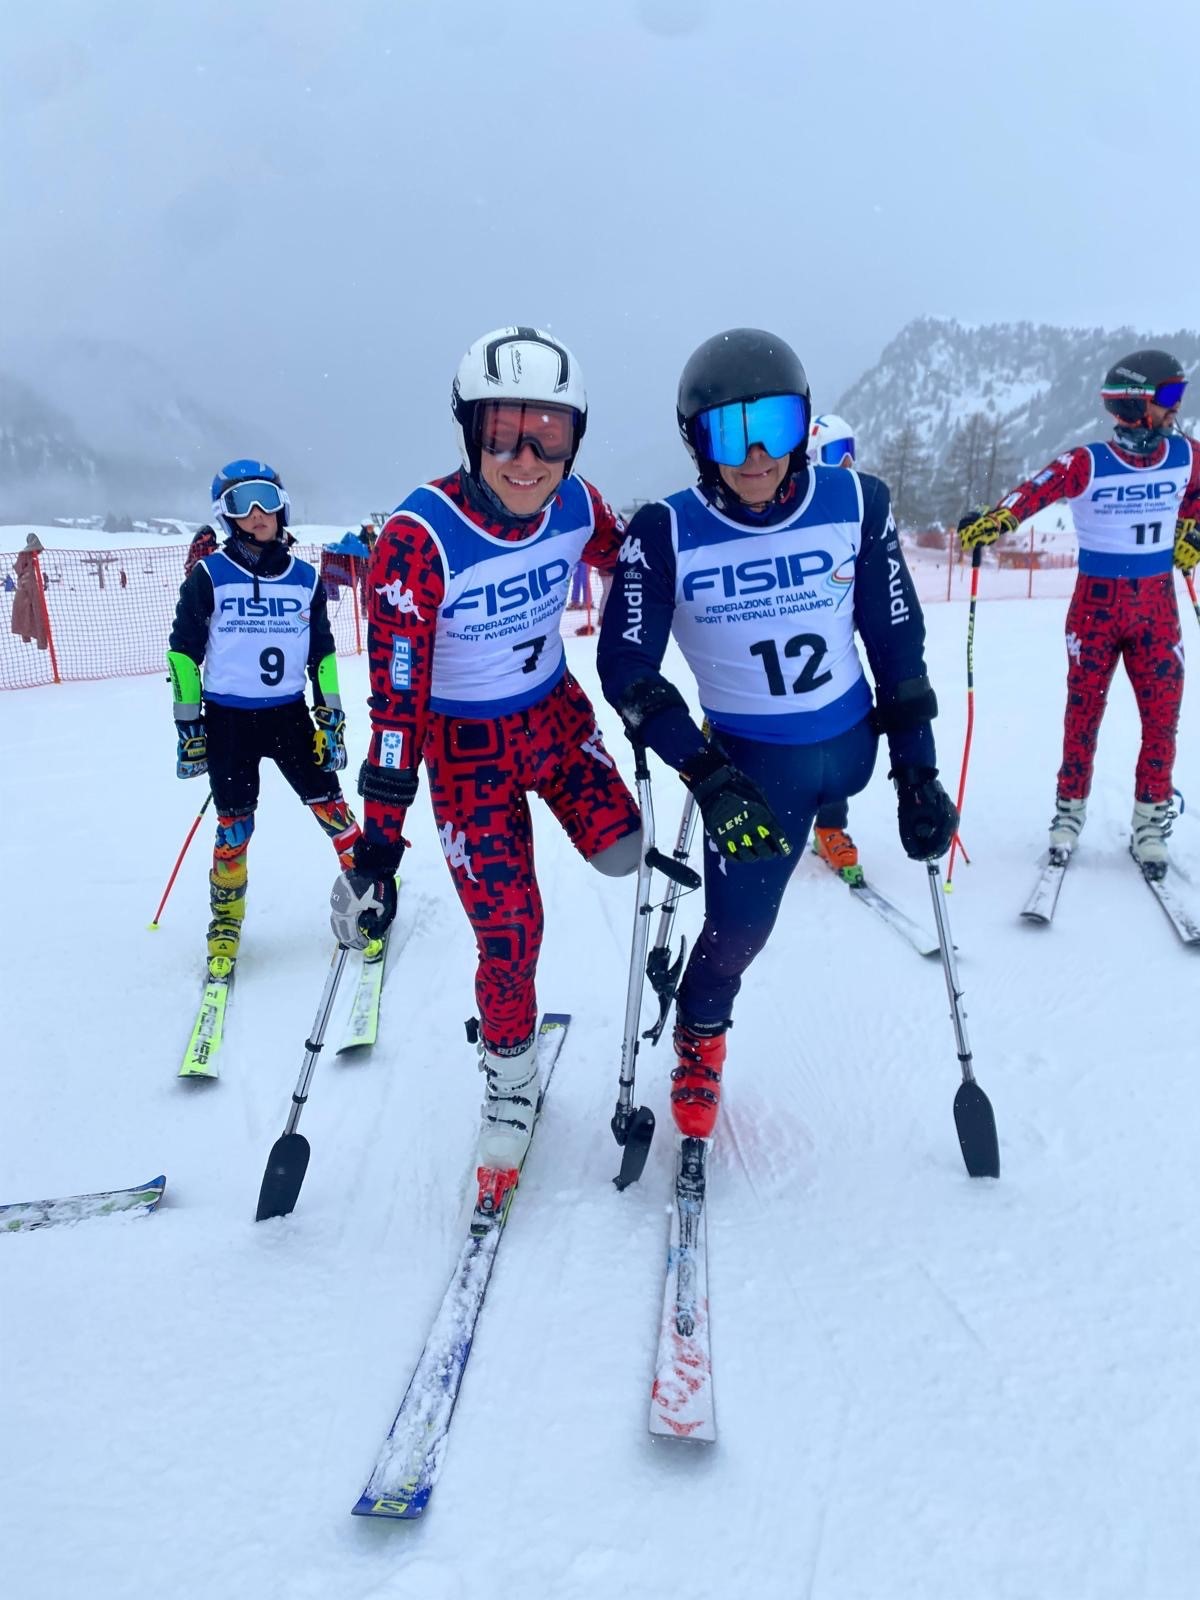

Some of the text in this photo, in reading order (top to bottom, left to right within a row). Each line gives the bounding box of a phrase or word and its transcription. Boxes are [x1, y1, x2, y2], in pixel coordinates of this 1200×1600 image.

[1091, 481, 1177, 502] FISIP
[1130, 521, 1162, 545] 11
[442, 558, 569, 618] FISIP
[683, 550, 833, 601] FISIP
[887, 557, 910, 625] Audi
[220, 597, 302, 617] FISIP
[464, 595, 559, 632] FEDERAZIONE ITALIANA
[622, 583, 643, 644] Audi
[694, 615, 722, 624] SPORT
[727, 609, 776, 623] INVERNALI
[706, 590, 817, 614] FEDERAZIONE ITALIANA
[446, 631, 480, 641] SPORT
[484, 622, 530, 640] INVERNALI
[259, 646, 285, 687] 9
[512, 635, 547, 674] 7
[749, 633, 833, 696] 12
[717, 810, 749, 835] LEKI
